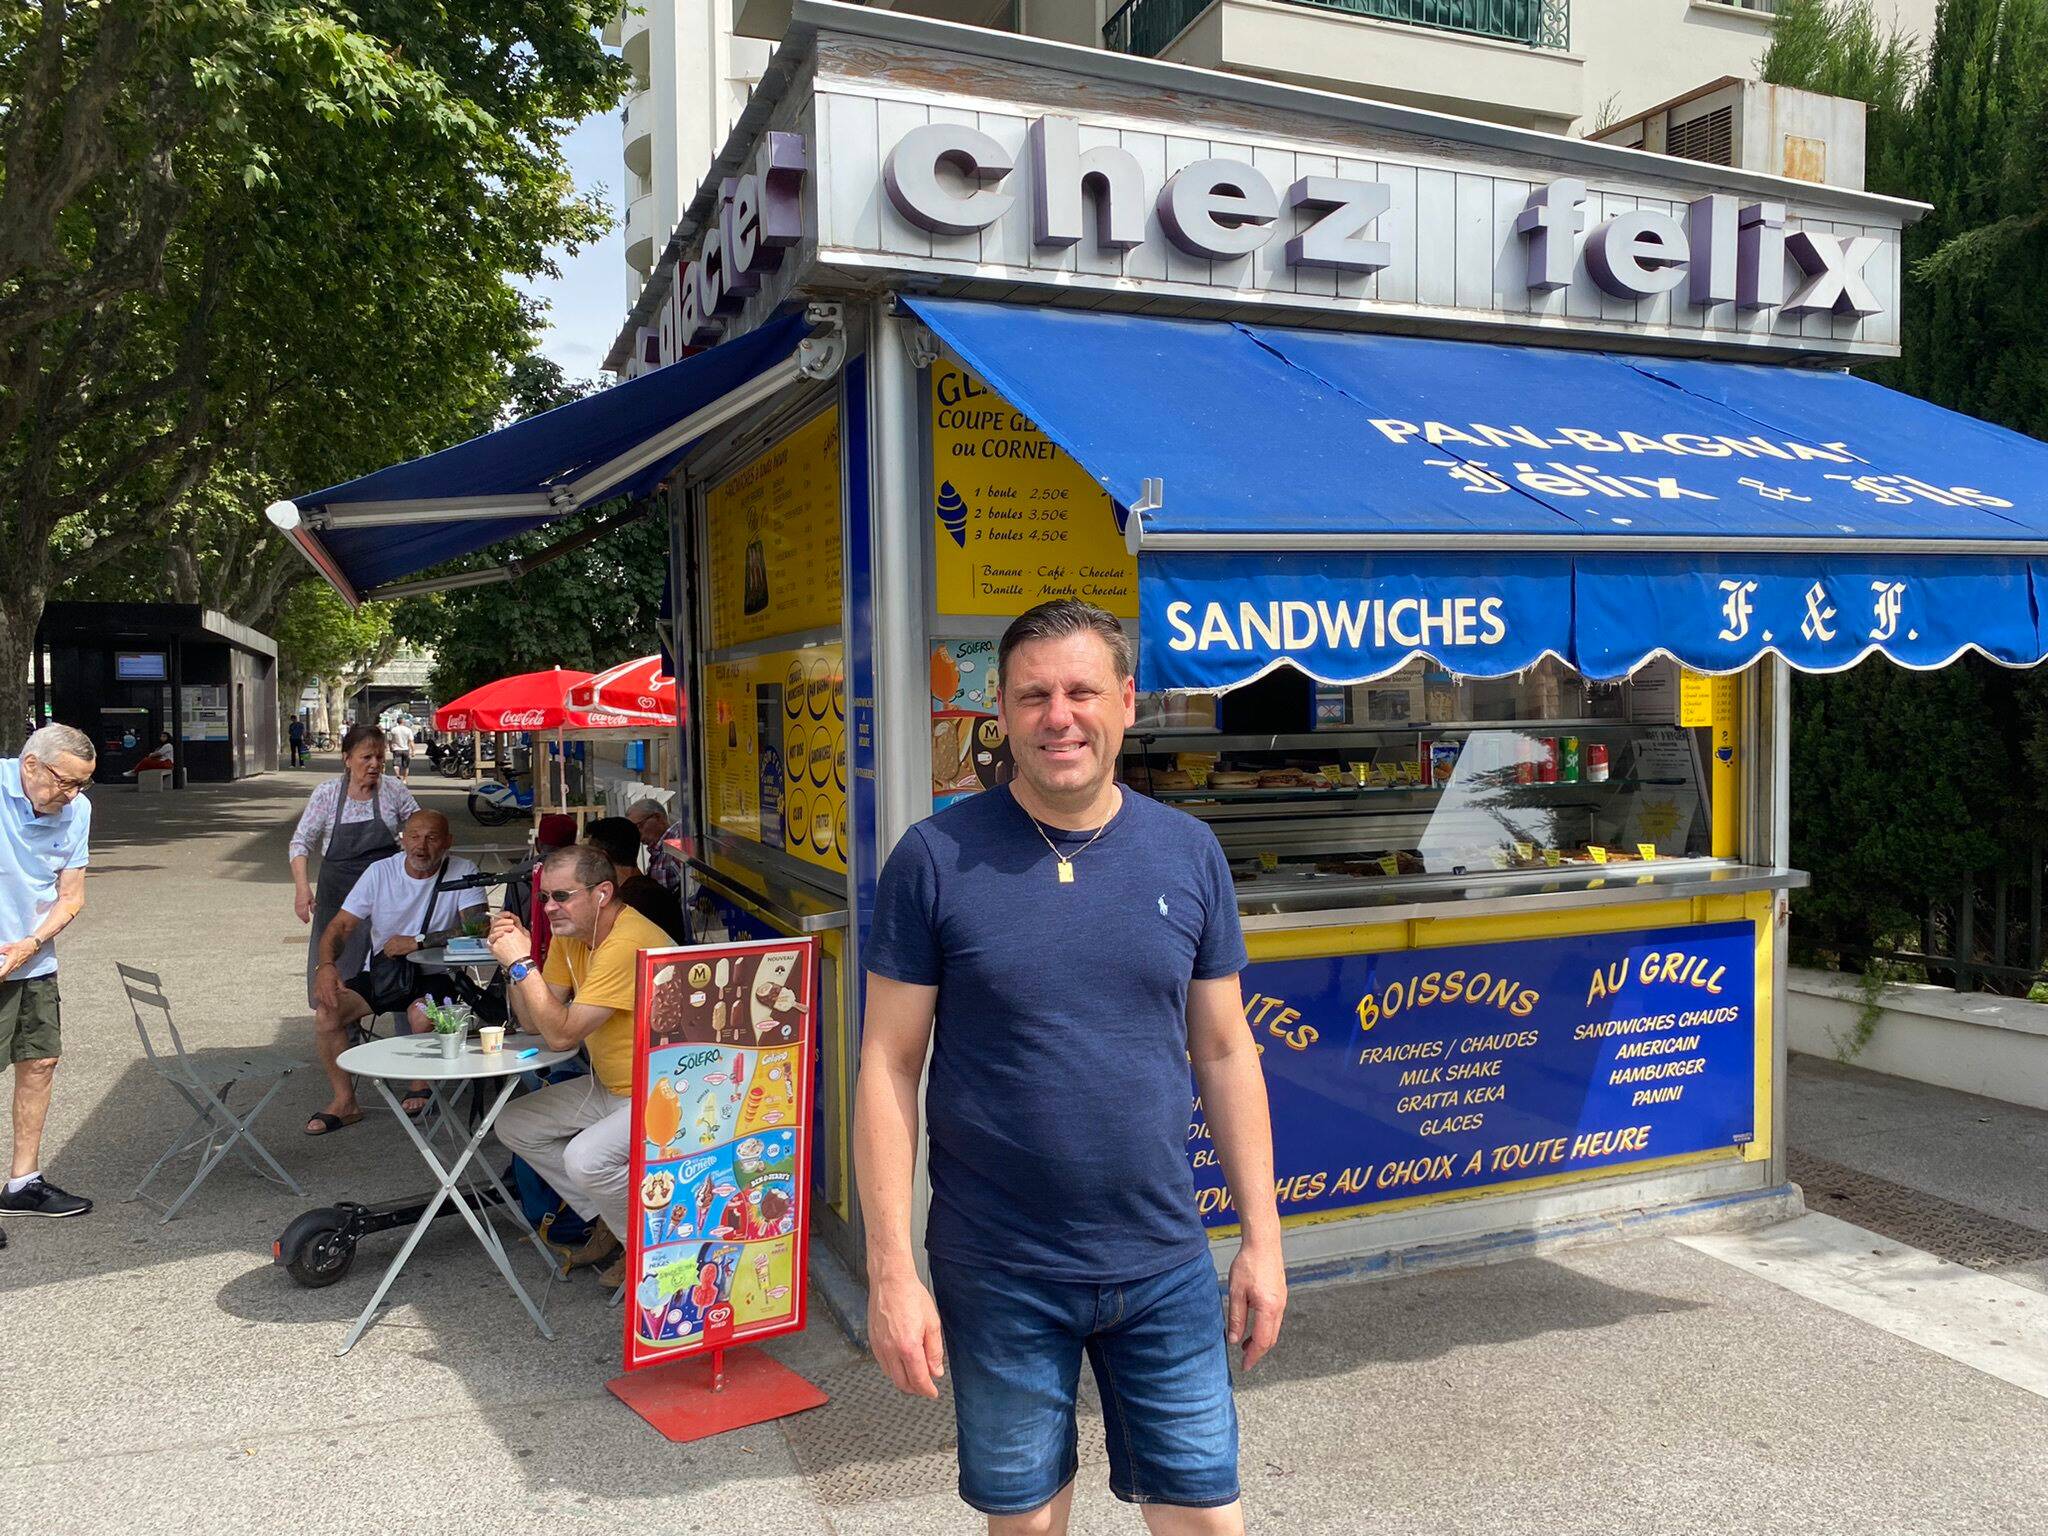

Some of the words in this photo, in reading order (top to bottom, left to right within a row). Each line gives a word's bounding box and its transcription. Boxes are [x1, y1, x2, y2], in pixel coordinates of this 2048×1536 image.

[884, 114, 1391, 274] chez
[1517, 177, 1884, 317] felix
[937, 372, 988, 406] GL
[938, 409, 1004, 431] COUPE
[952, 442, 975, 456] ou
[981, 438, 1058, 460] CORNET
[1368, 418, 1871, 464] PAN-BAGNAT
[974, 487, 981, 497] 1
[988, 486, 1017, 498] boule
[1423, 459, 1719, 500] Félix
[1823, 473, 2014, 507] Fils
[974, 509, 982, 519] 2
[988, 508, 1023, 520] boules
[974, 530, 982, 540] 3
[989, 529, 1023, 541] boules
[981, 564, 1023, 577] Banane
[1037, 565, 1065, 579] Café
[1079, 566, 1124, 578] Chocolat
[981, 582, 1023, 596] Vanille
[1037, 583, 1077, 597] Menthe
[1082, 584, 1127, 596] Chocolat
[1167, 597, 1506, 652] SANDWICHES
[1718, 580, 1773, 642] F.
[1800, 580, 1838, 643] &
[1868, 580, 1919, 641] F.
[500, 709, 546, 727] Coca-Cola
[1586, 957, 1630, 1007] AU
[1639, 951, 1728, 996] GRILL
[1355, 969, 1541, 1032] BOISSONS
[1573, 1013, 1676, 1041] SANDWICHES
[1678, 1006, 1739, 1029] CHAUDS
[1359, 1040, 1443, 1065] FRAICHES
[1460, 1029, 1539, 1055] CHAUDES
[1615, 1036, 1701, 1060] AMERICAIN
[1399, 1065, 1442, 1088] MILK
[1446, 1060, 1503, 1082] SHAKE
[1608, 1057, 1707, 1087] HAMBURGER
[1397, 1090, 1459, 1114] GRATTA
[1463, 1085, 1506, 1105] KEKA
[1632, 1085, 1684, 1107] PANINI
[1420, 1113, 1484, 1136] GLACES
[677, 1156, 718, 1184] Cornetto
[1331, 1165, 1374, 1195] AU
[1377, 1153, 1459, 1189] CHOIX
[1462, 1150, 1483, 1178] A
[1491, 1136, 1568, 1174] TOUTE
[1571, 1125, 1653, 1158] HEURE
